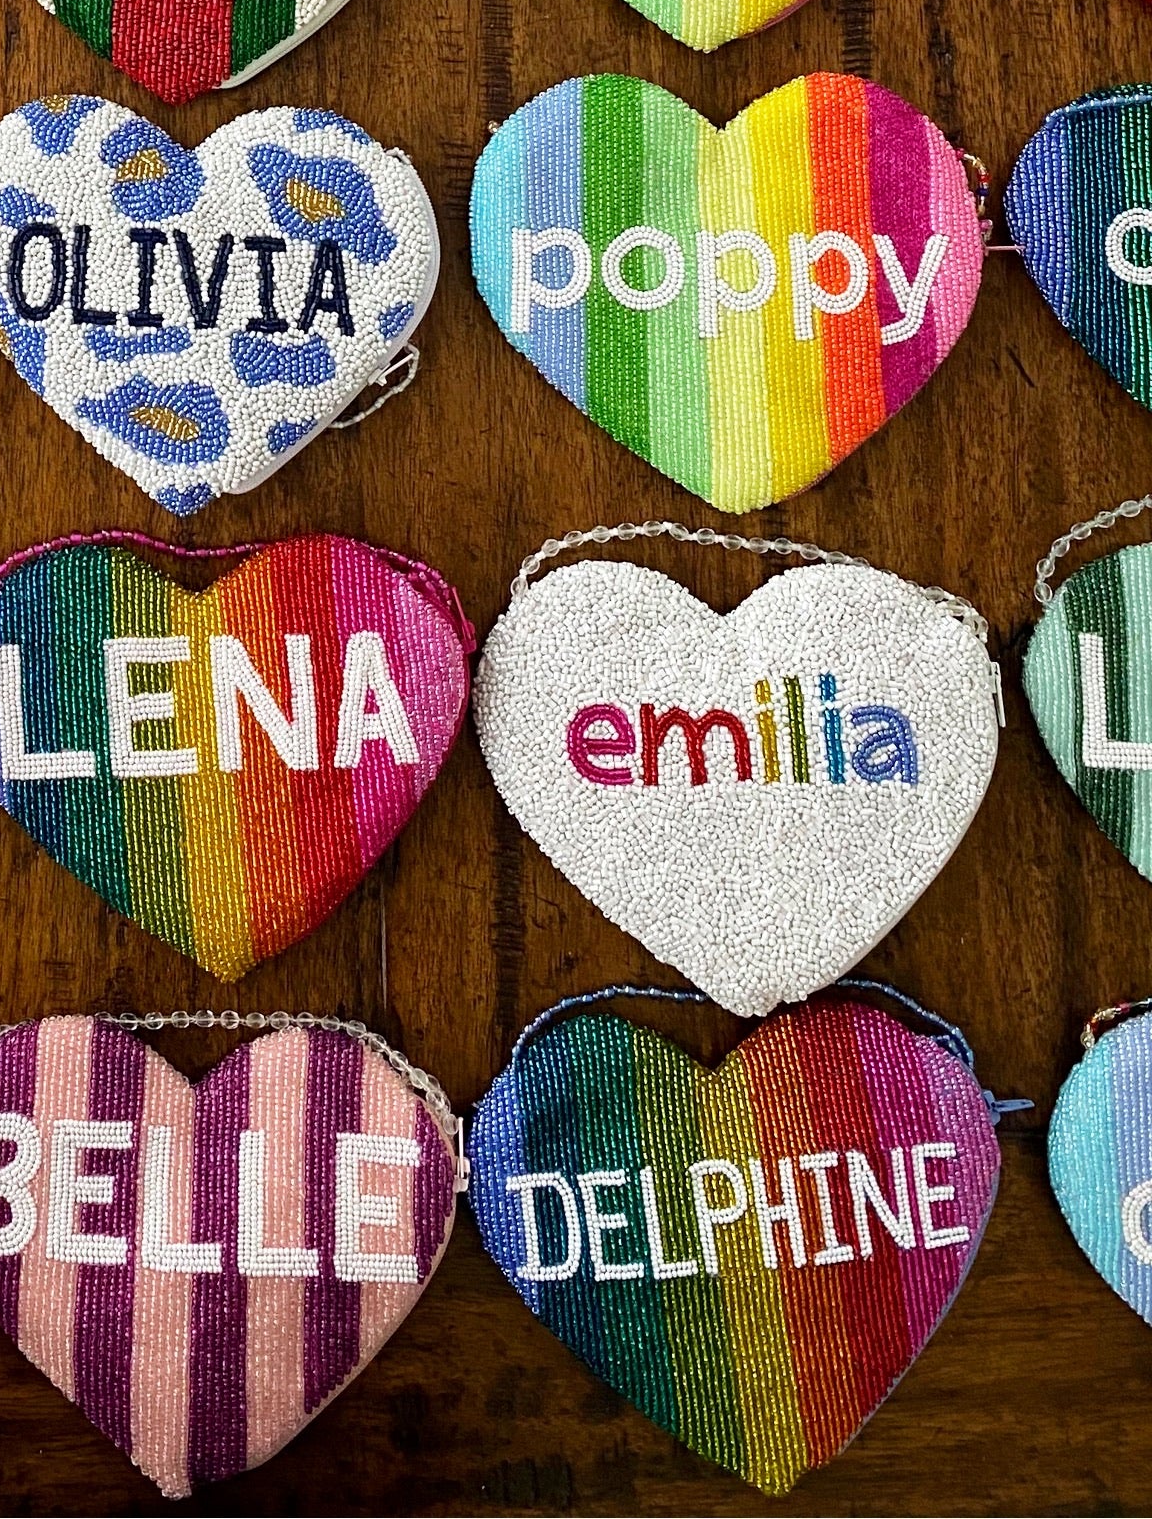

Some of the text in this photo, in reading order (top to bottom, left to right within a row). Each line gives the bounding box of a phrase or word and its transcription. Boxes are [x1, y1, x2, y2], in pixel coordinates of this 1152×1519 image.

[7, 222, 355, 336] OLIVIA
[509, 225, 950, 346] poppy
[566, 672, 919, 786] emilia
[505, 1141, 970, 1282] DELPHINE
